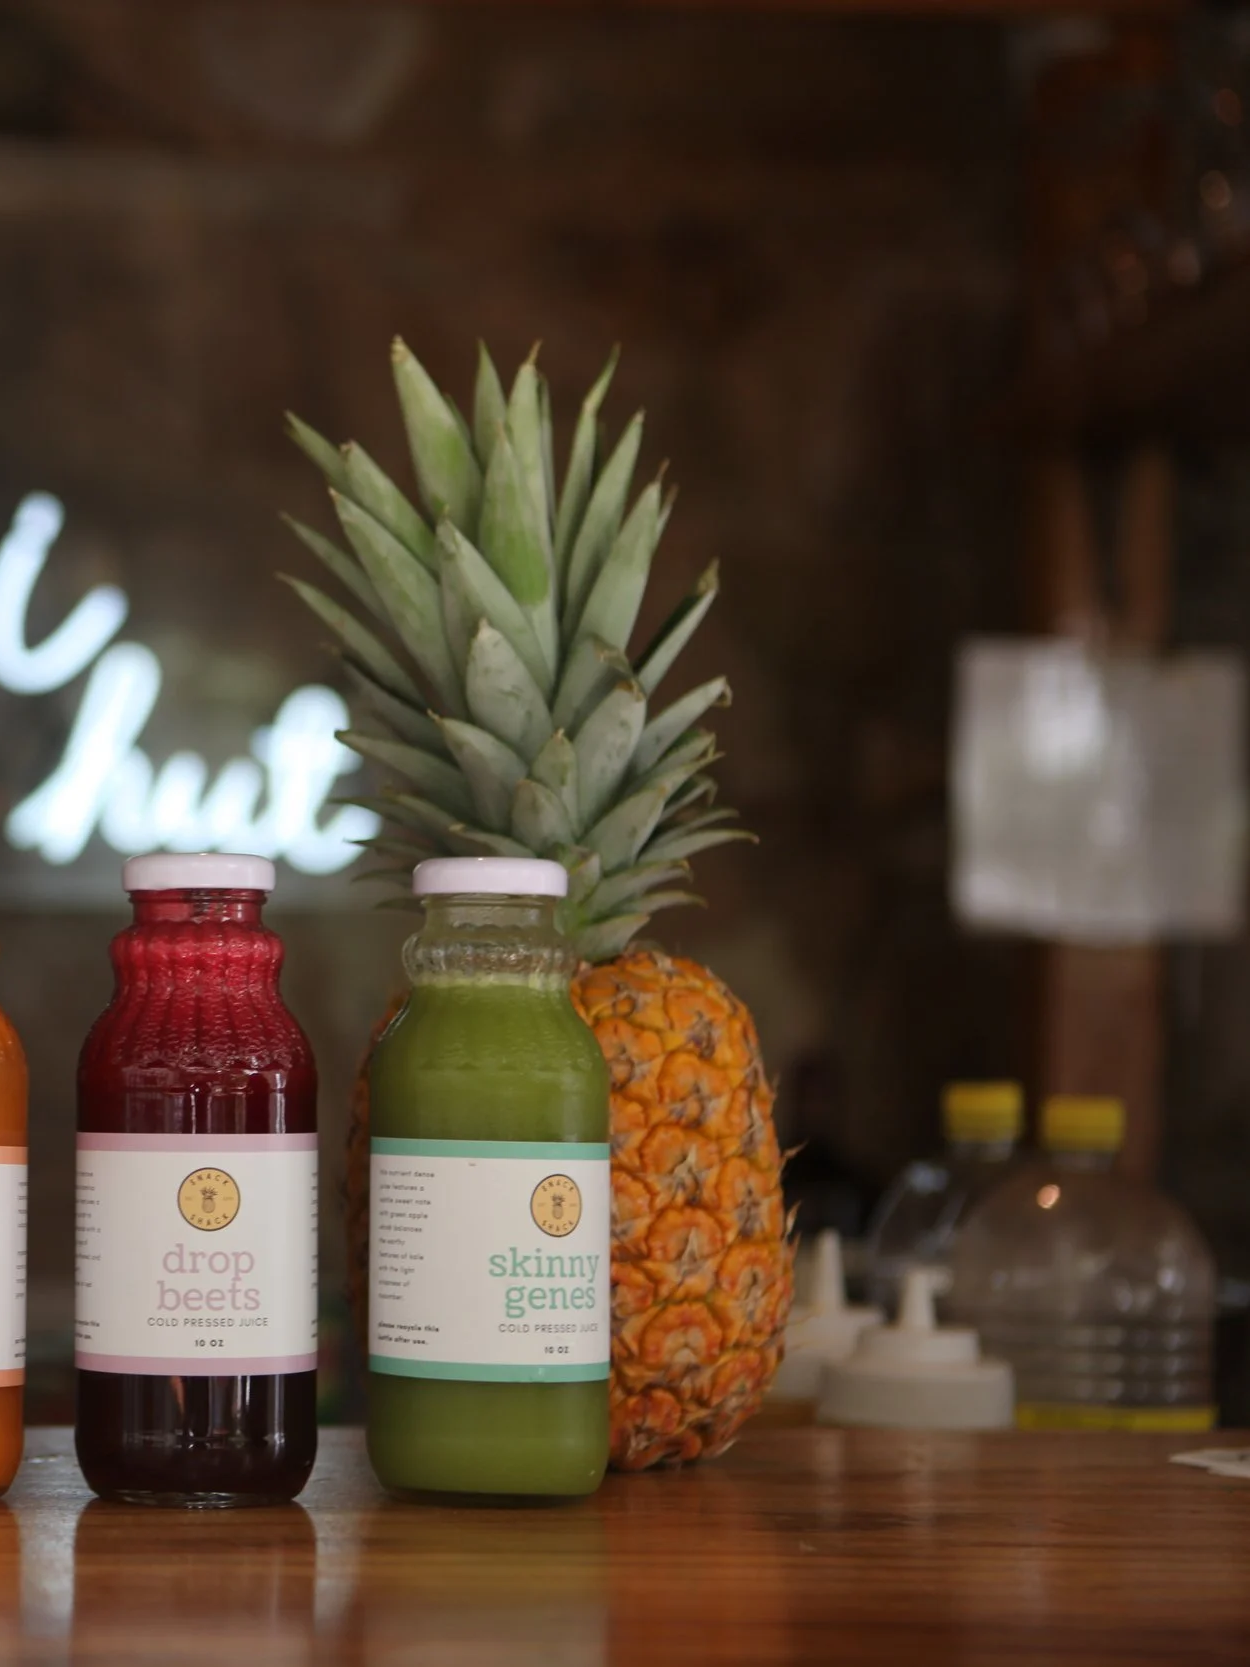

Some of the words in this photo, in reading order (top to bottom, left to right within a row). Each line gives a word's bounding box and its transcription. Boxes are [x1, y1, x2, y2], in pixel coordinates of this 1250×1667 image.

[5, 640, 382, 875] hut
[162, 1243, 255, 1281] drop
[488, 1247, 600, 1283] skinny
[156, 1280, 261, 1312] beets
[504, 1285, 596, 1319] genes
[147, 1317, 178, 1327] COLD
[183, 1318, 234, 1328] PRESSED
[239, 1317, 269, 1327] JUICE
[499, 1323, 530, 1333] COLD
[534, 1324, 577, 1333] PRESSED
[580, 1323, 599, 1332] JUICE
[195, 1339, 206, 1347] 10
[210, 1339, 224, 1347] OZ
[544, 1346, 555, 1354] 10
